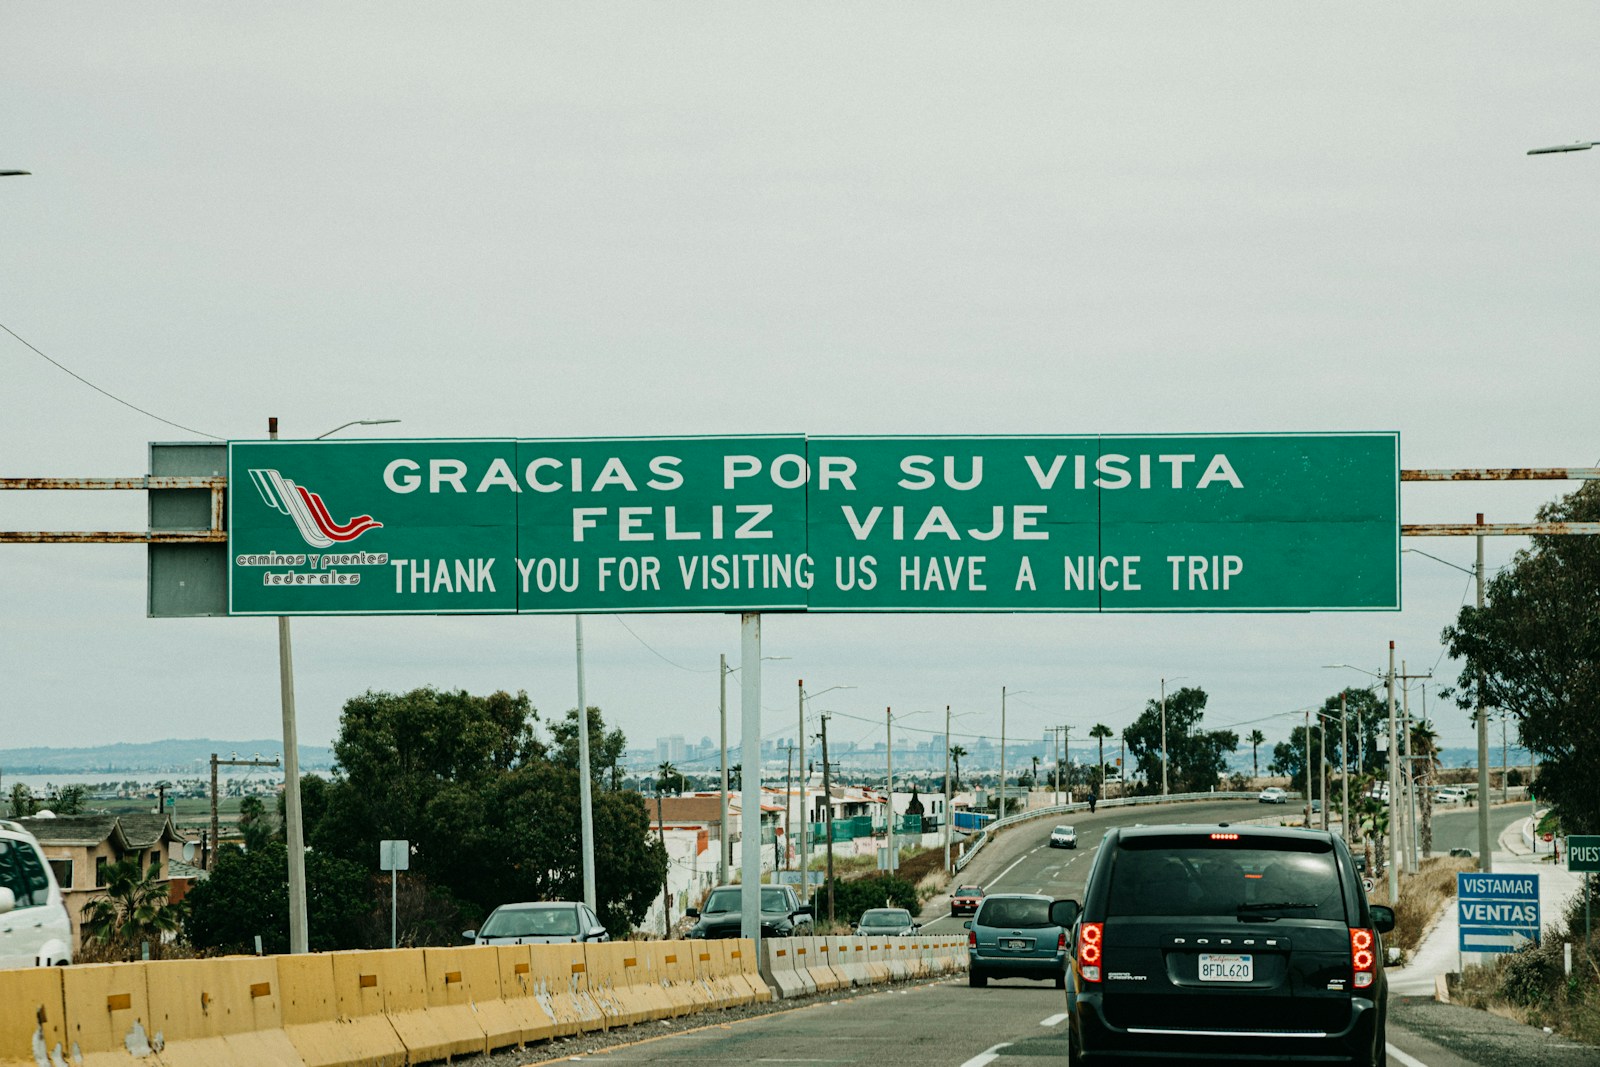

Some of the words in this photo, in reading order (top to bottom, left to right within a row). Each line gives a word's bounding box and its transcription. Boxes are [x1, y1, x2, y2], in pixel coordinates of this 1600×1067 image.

[383, 456, 685, 494] GRACIAS
[723, 453, 857, 491] POR
[897, 455, 984, 491] SU
[1024, 453, 1245, 490] VISITA
[572, 504, 773, 542] FELIZ
[841, 505, 1050, 541] VIAJE
[236, 551, 306, 566] caminos
[321, 551, 388, 569] puentes
[263, 570, 361, 586] federales
[390, 558, 496, 594] THANK
[514, 557, 579, 594] YOU
[598, 556, 661, 592] FOR
[678, 553, 815, 590] VISITING
[835, 555, 878, 591] US
[900, 556, 987, 591] HAVE
[1015, 556, 1037, 591] A
[1064, 555, 1142, 591] NICE
[1166, 555, 1244, 591] TRIP
[1463, 879, 1533, 894] VISTAMAR
[1461, 904, 1537, 922] VENTAS
[1202, 964, 1249, 977] 8FDL620
